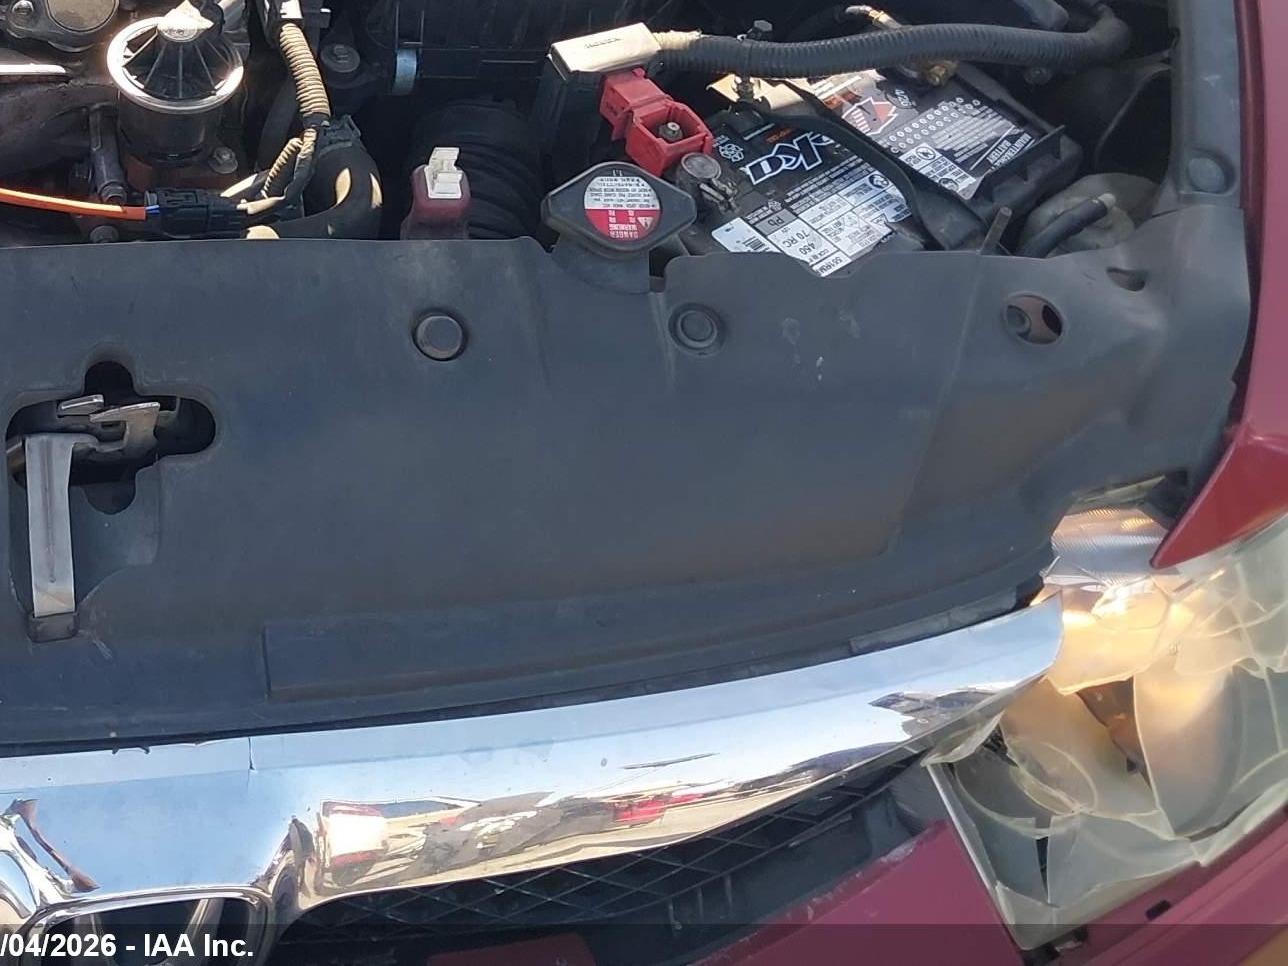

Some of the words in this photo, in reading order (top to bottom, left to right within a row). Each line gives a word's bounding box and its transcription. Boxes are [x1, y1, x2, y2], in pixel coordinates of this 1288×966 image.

[986, 139, 1012, 164] BATTERY
[767, 216, 785, 227] Pb
[609, 230, 639, 239] DANGER
[797, 230, 810, 241] 70
[782, 237, 799, 248] RC
